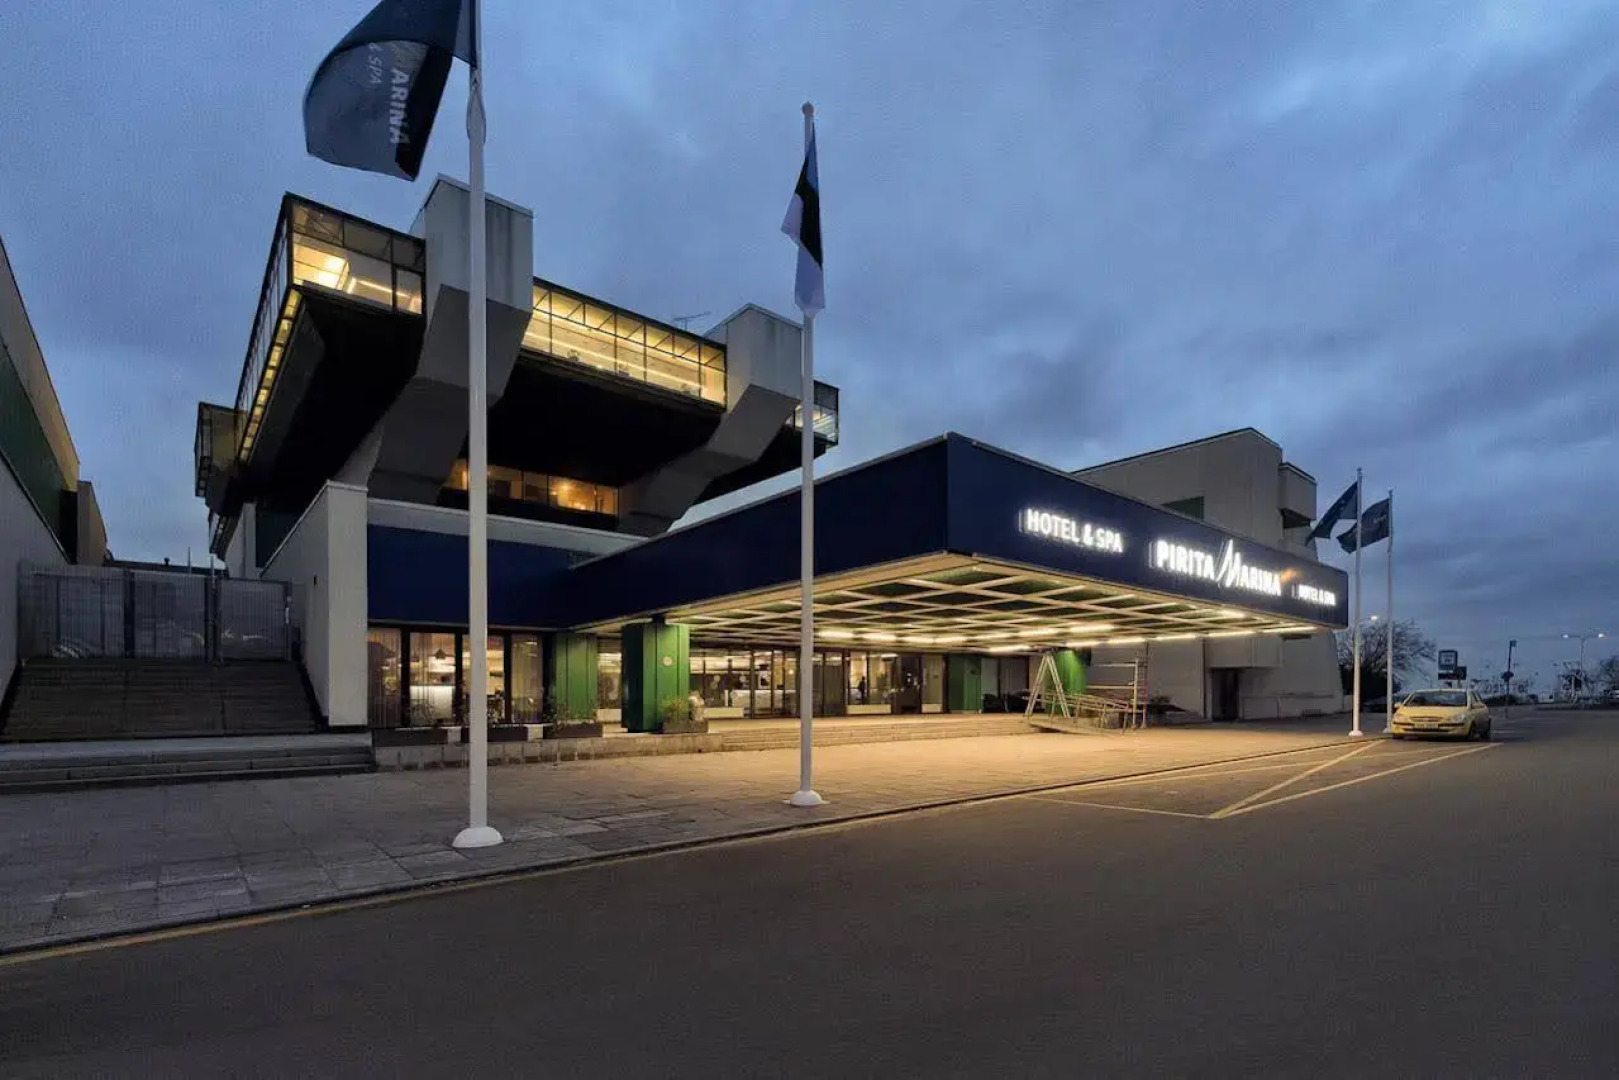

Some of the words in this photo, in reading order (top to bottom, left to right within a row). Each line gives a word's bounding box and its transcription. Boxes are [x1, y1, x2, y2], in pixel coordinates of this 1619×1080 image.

[368, 56, 383, 84] SPA
[1027, 508, 1080, 543] HOTEL
[1096, 528, 1124, 553] SPA
[1156, 540, 1215, 581] PIRITA
